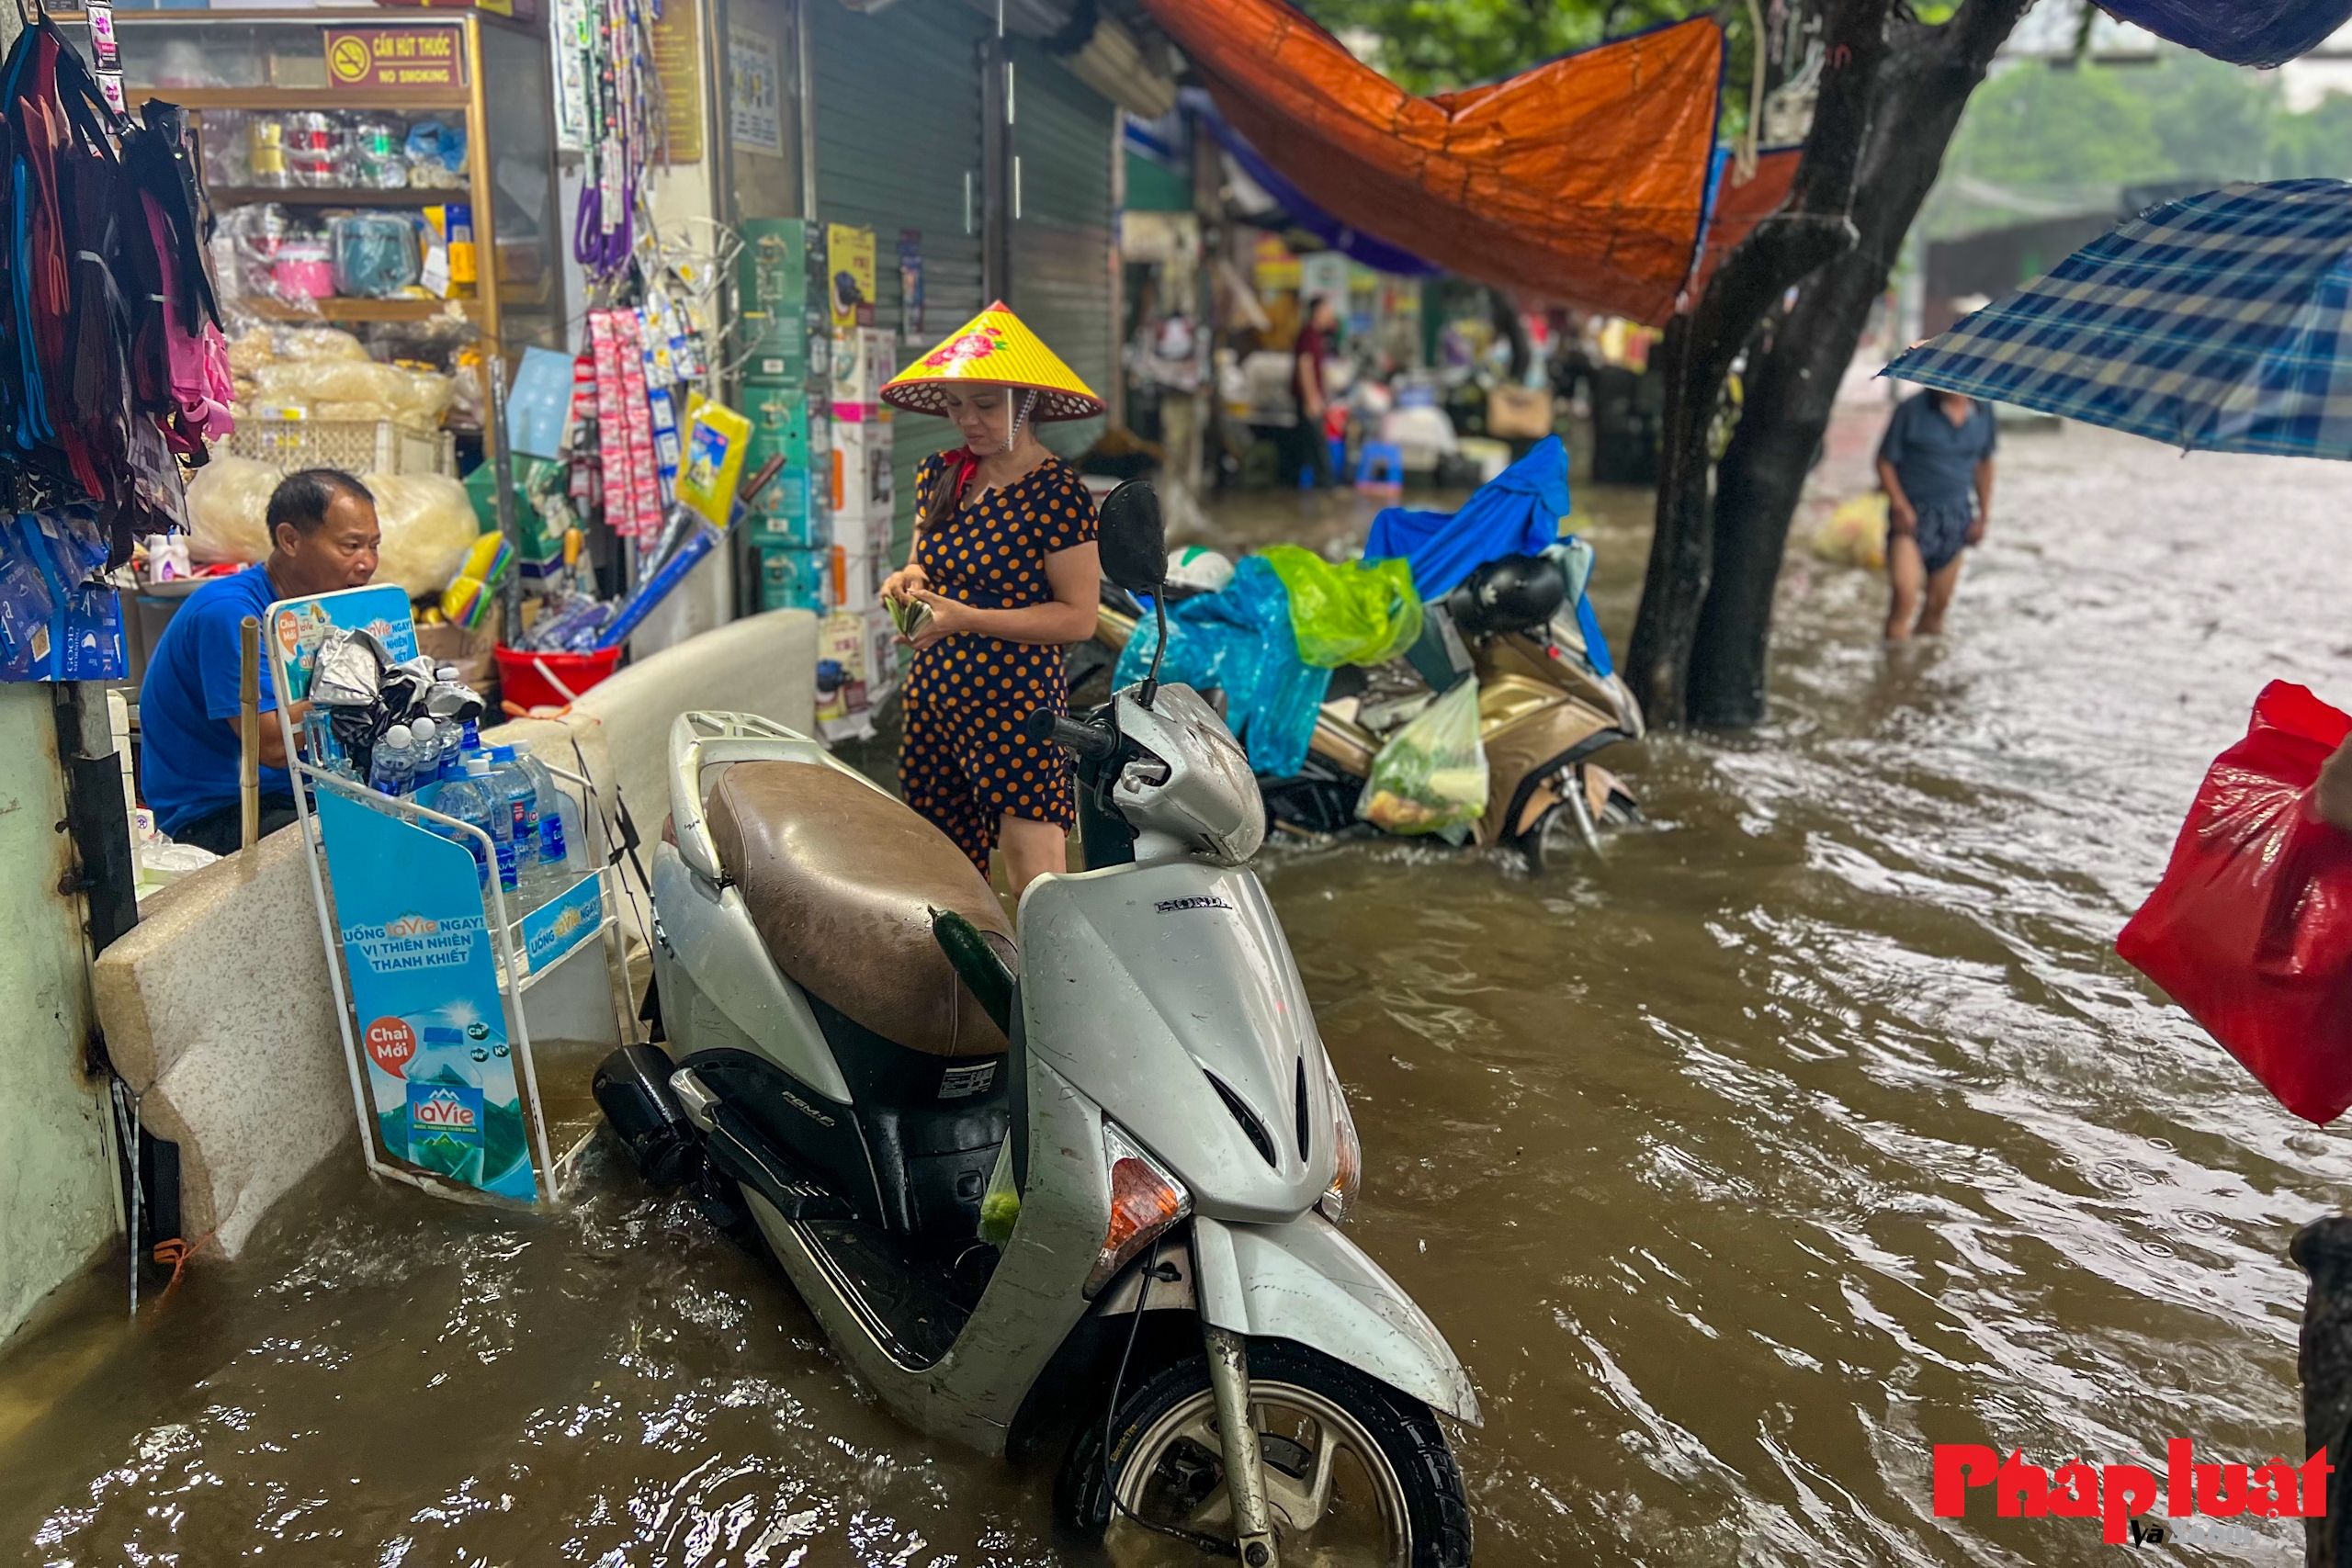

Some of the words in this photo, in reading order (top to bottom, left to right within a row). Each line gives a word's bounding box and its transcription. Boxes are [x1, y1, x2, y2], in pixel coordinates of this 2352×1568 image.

[379, 70, 396, 83] NO
[399, 69, 449, 83] SMOKING
[279, 616, 296, 629] Chai
[386, 918, 437, 937] laVie
[440, 918, 484, 931] NGAY!
[362, 944, 378, 957] VỊ
[380, 938, 424, 953] THIÊN
[427, 932, 471, 949] NHIÊN
[372, 956, 423, 971] THANH
[426, 948, 467, 965] KHIẾT
[370, 1025, 409, 1042] Chai
[376, 1043, 409, 1059] Mới
[414, 1100, 474, 1125] laVie
